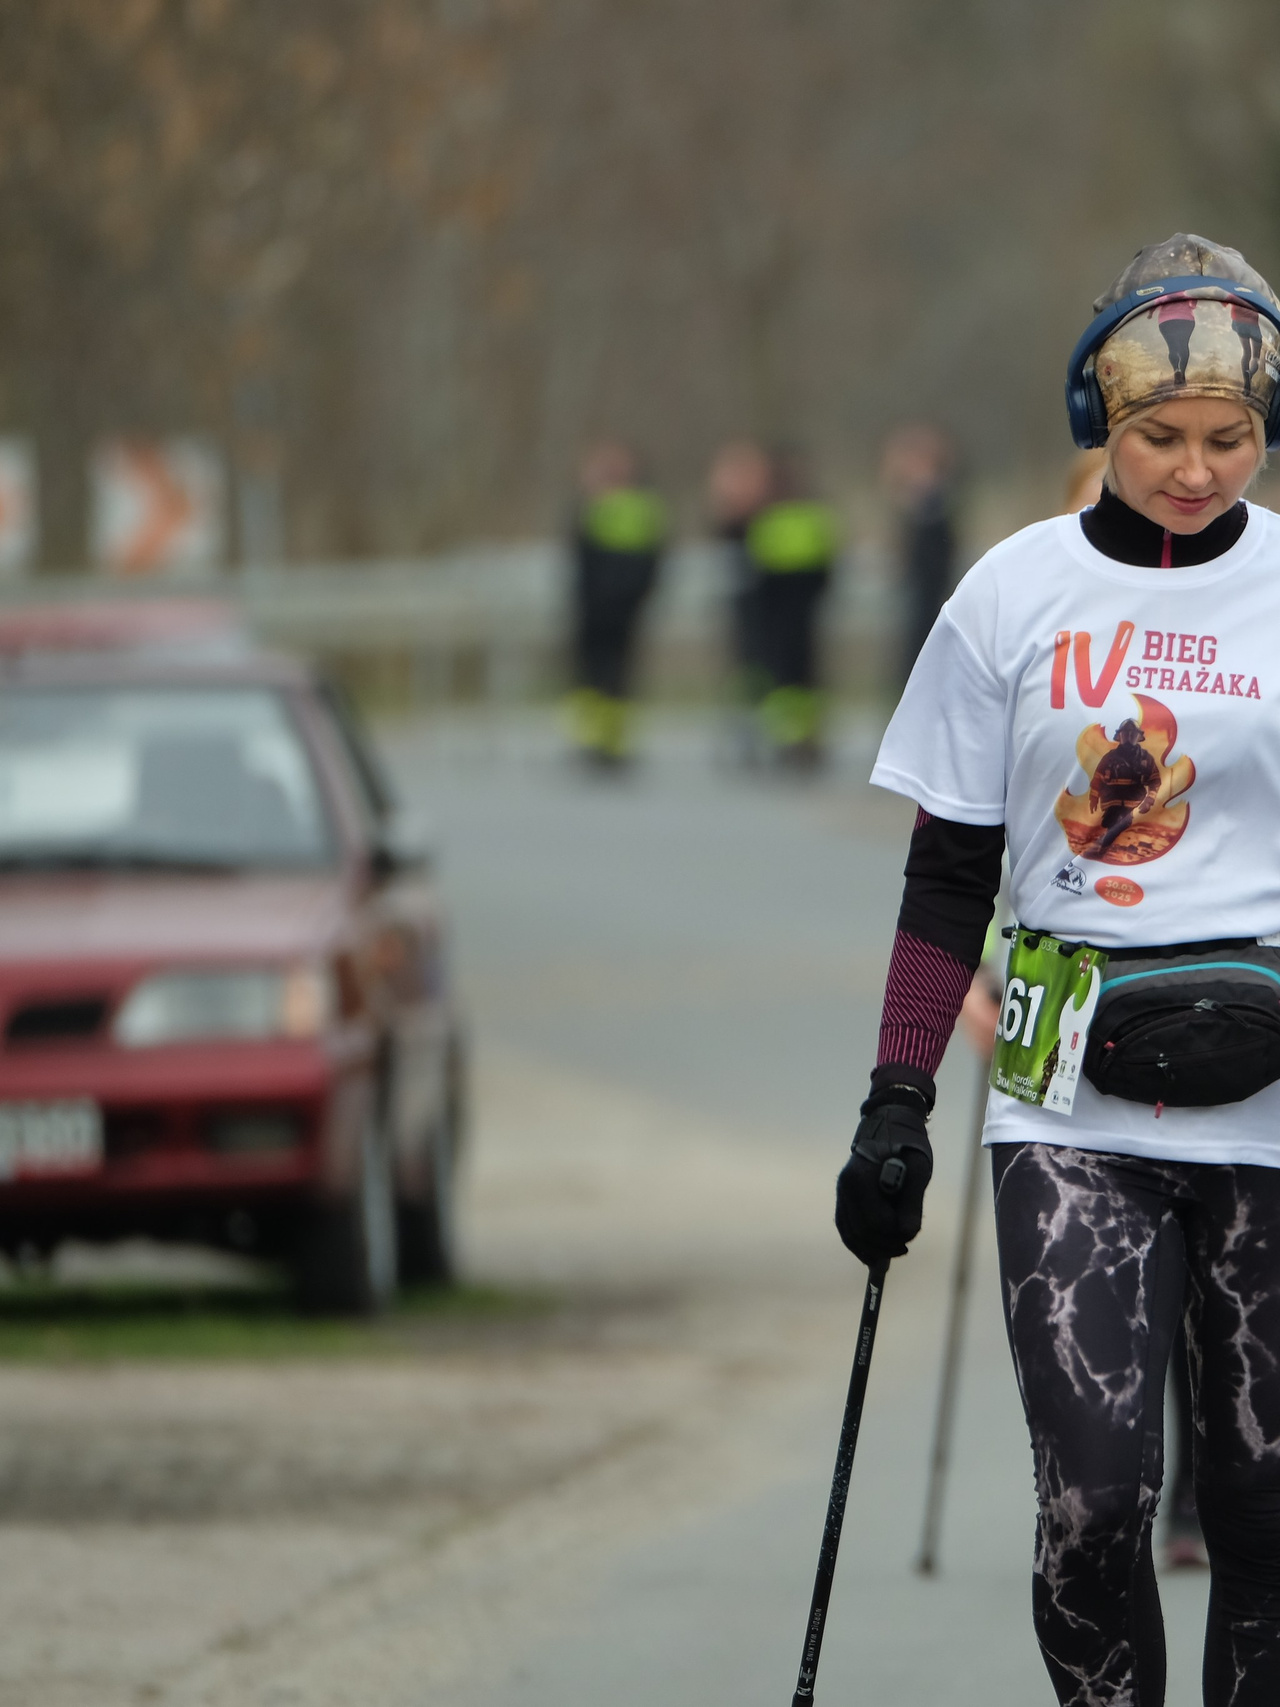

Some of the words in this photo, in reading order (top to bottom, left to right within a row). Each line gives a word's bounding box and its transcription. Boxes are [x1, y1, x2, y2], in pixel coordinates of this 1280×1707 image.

[1142, 630, 1218, 665] BIEG
[1050, 620, 1135, 709] IV
[1125, 666, 1262, 700] STRAŻAKA
[996, 977, 1045, 1048] 61
[1011, 1083, 1037, 1102] Walking
[1012, 1072, 1035, 1088] Nordic
[811, 1607, 822, 1632] NORDIC
[806, 1633, 817, 1662] WALKING
